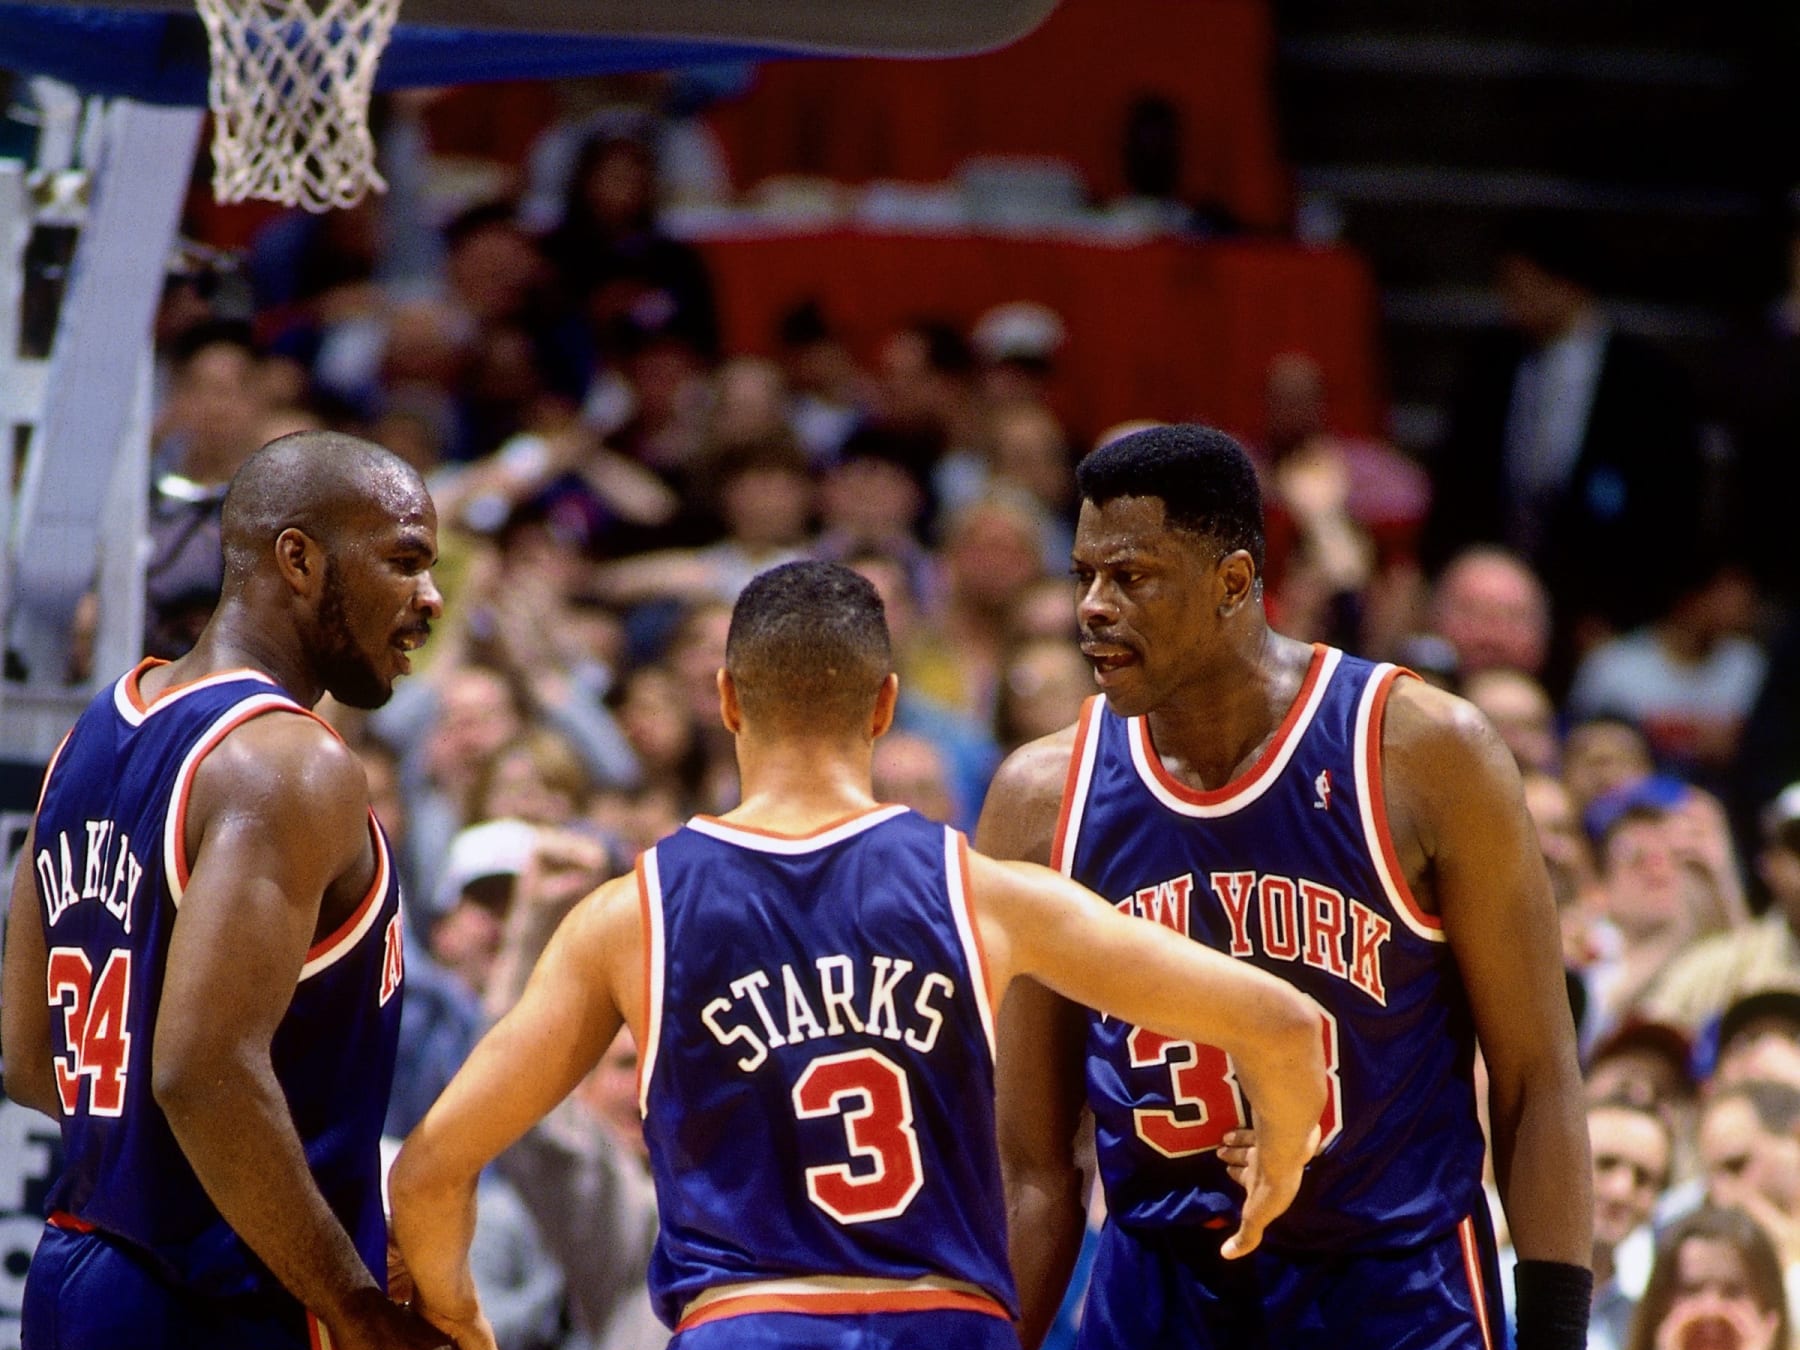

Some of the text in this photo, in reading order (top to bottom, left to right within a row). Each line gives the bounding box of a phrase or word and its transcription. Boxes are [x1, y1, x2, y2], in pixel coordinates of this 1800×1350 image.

[37, 820, 142, 934] OAKLEY
[1211, 870, 1391, 1007] YORK
[48, 946, 131, 1117] 34
[702, 954, 955, 1072] STARKS
[1127, 993, 1343, 1158] 3
[792, 1048, 924, 1224] 3
